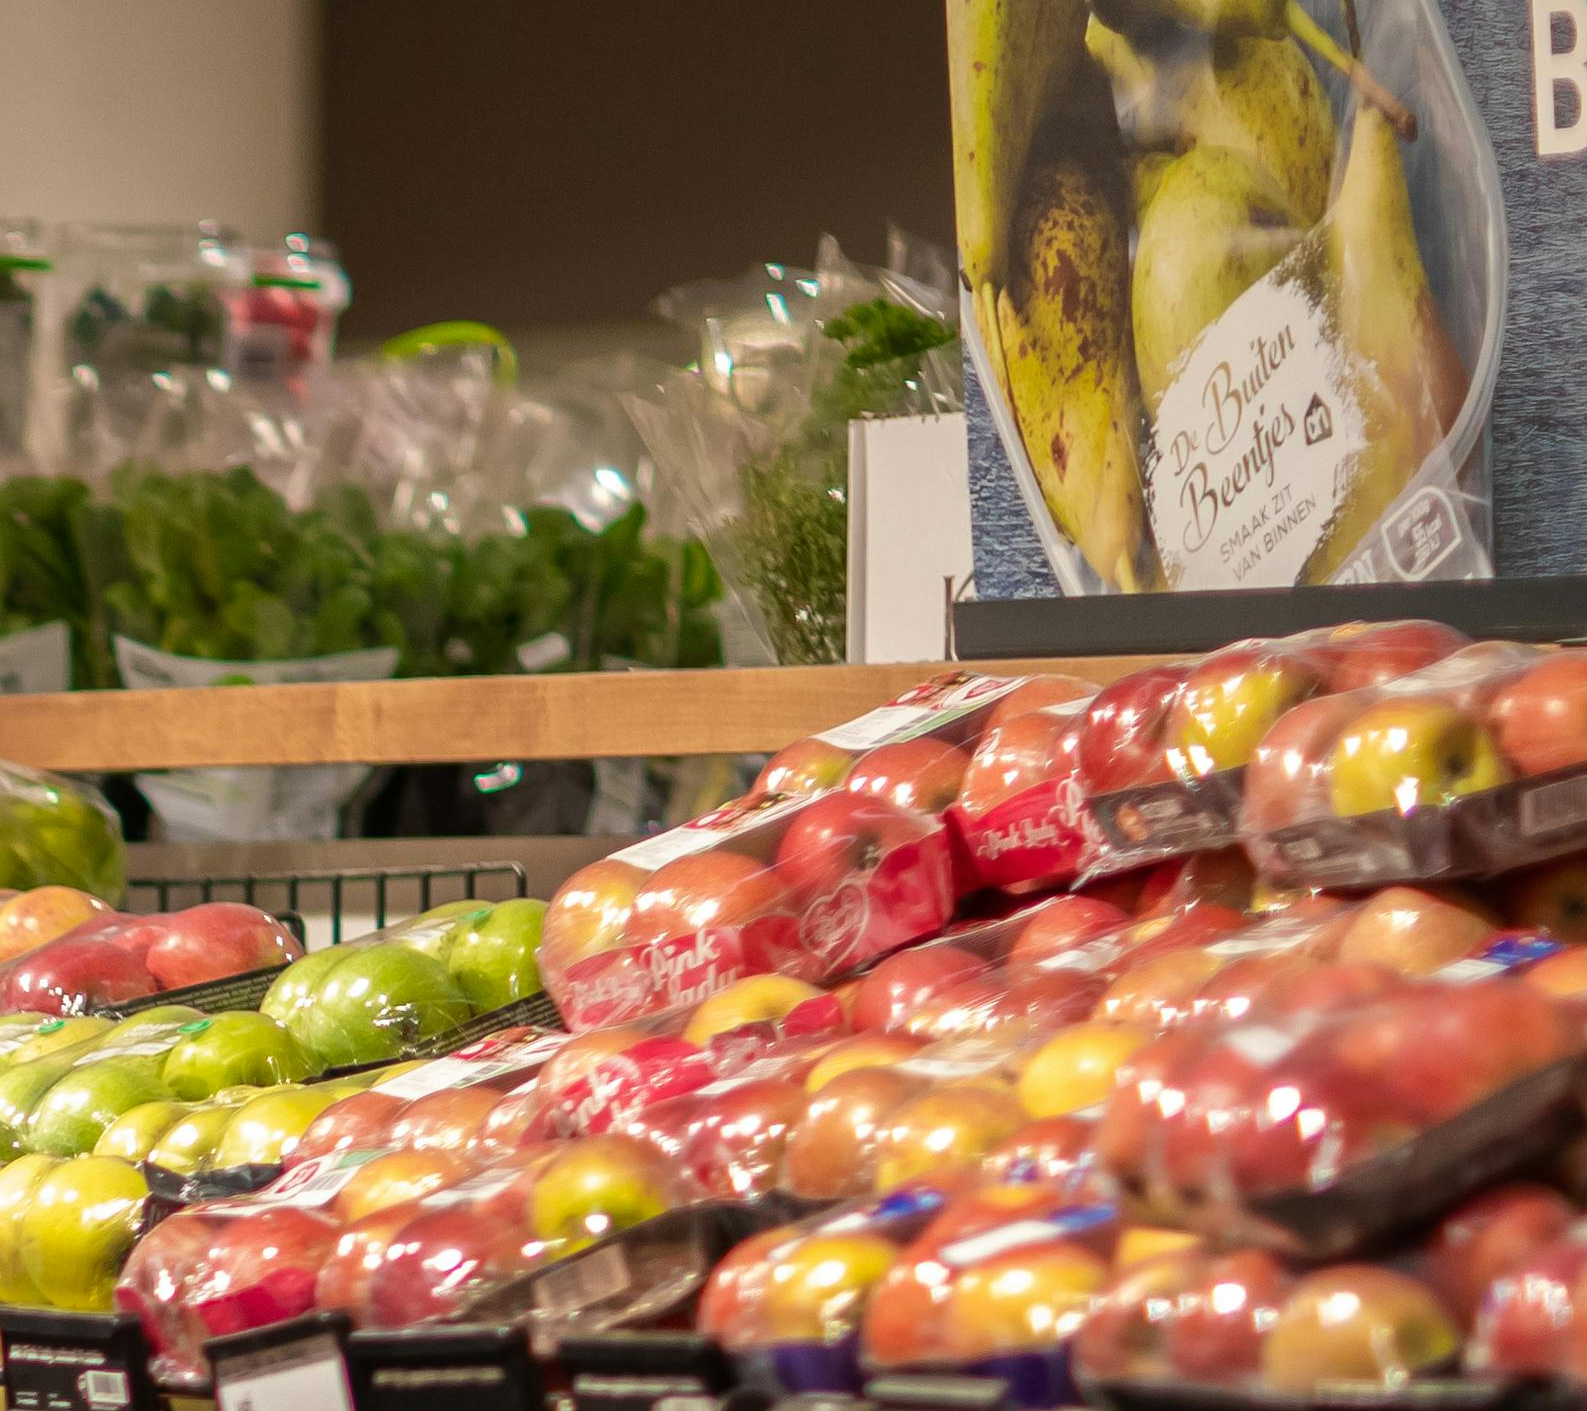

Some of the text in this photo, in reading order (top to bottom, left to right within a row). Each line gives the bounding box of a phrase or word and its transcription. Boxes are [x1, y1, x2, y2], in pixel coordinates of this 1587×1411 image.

[1170, 430, 1198, 476] De
[1202, 324, 1295, 455] Buiten
[1180, 403, 1295, 553] Beentjes
[1220, 484, 1293, 563] SMAAK ZIT
[1232, 493, 1316, 582] VAN BINNEN
[639, 927, 721, 992] Pink
